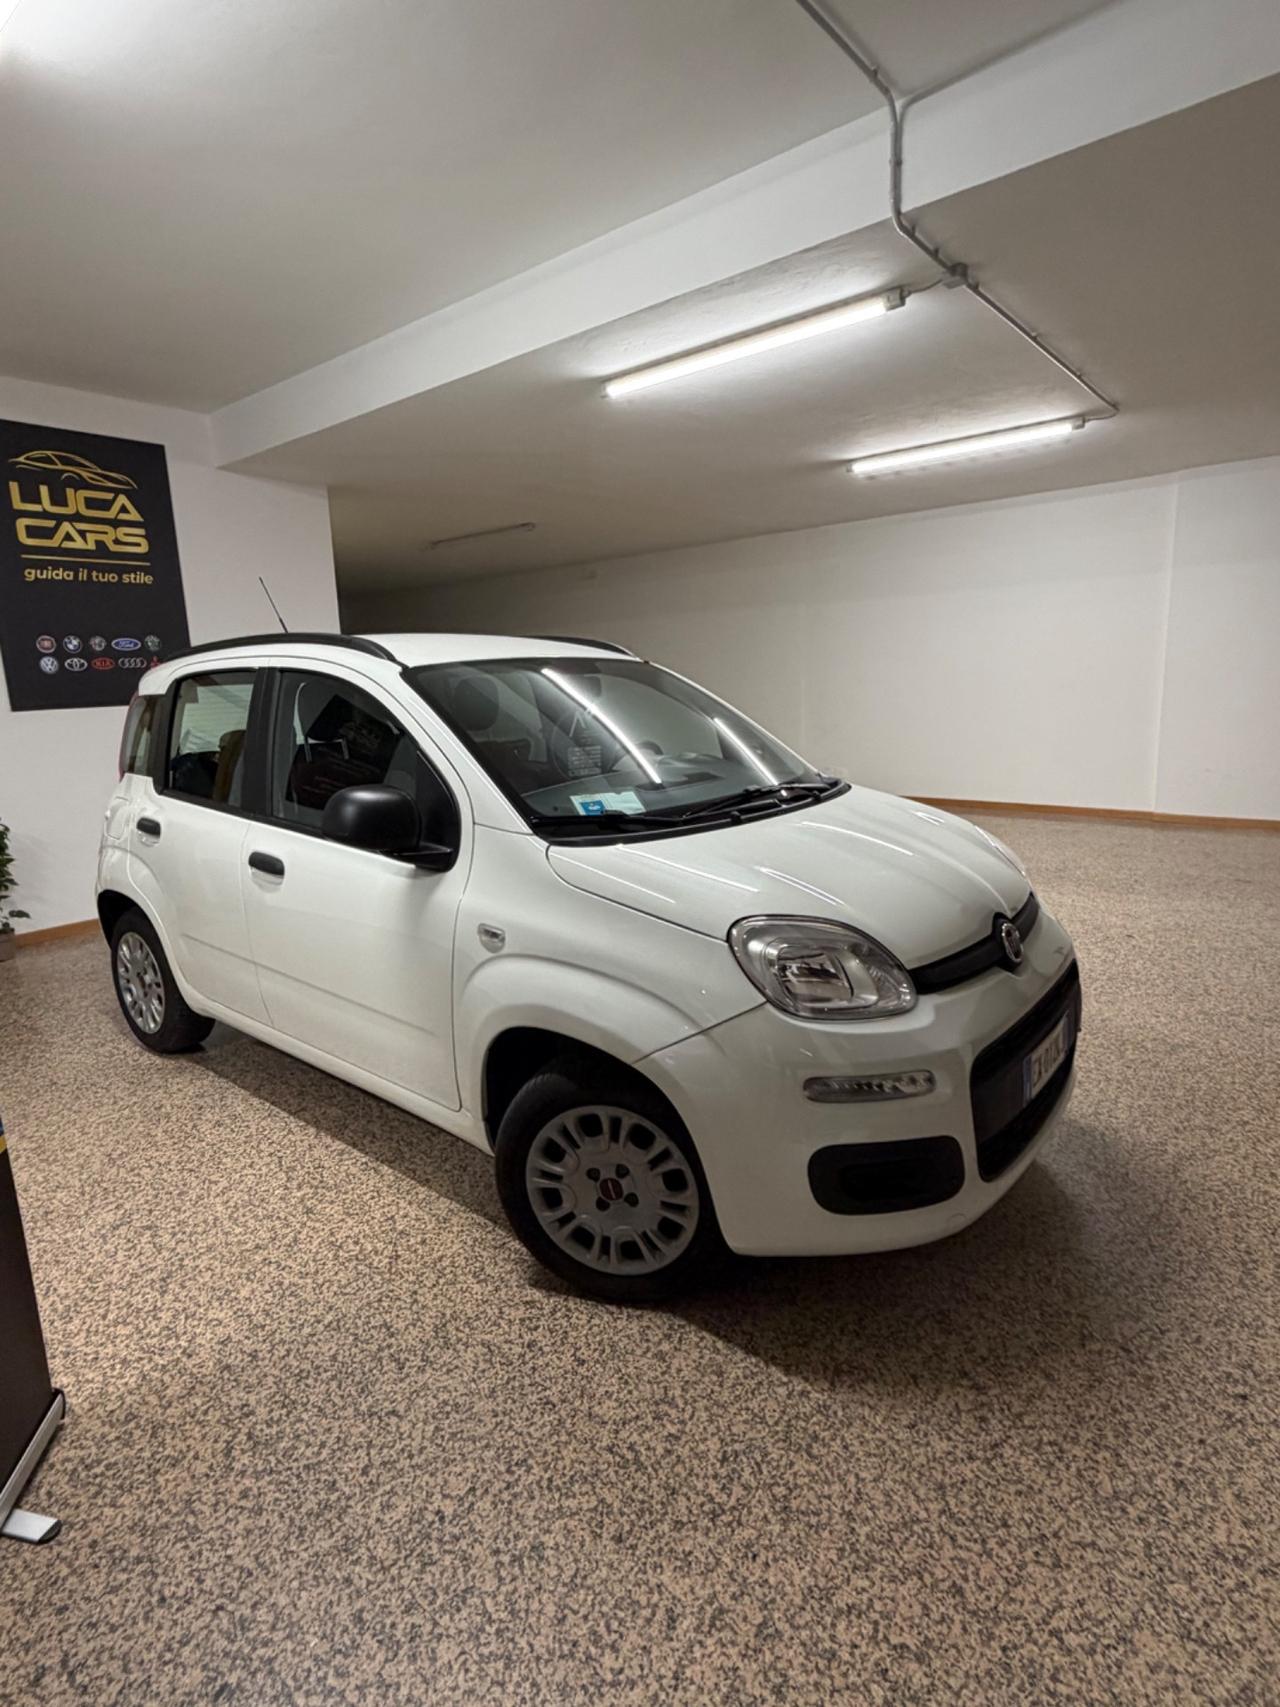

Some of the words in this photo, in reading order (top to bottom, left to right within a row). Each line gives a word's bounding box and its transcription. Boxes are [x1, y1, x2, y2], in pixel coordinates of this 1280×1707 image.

[9, 481, 144, 521] LUCA
[16, 517, 149, 553] CARS
[24, 566, 74, 582] guida
[78, 568, 88, 581] il
[91, 570, 119, 583] tuo
[122, 572, 154, 584] stile
